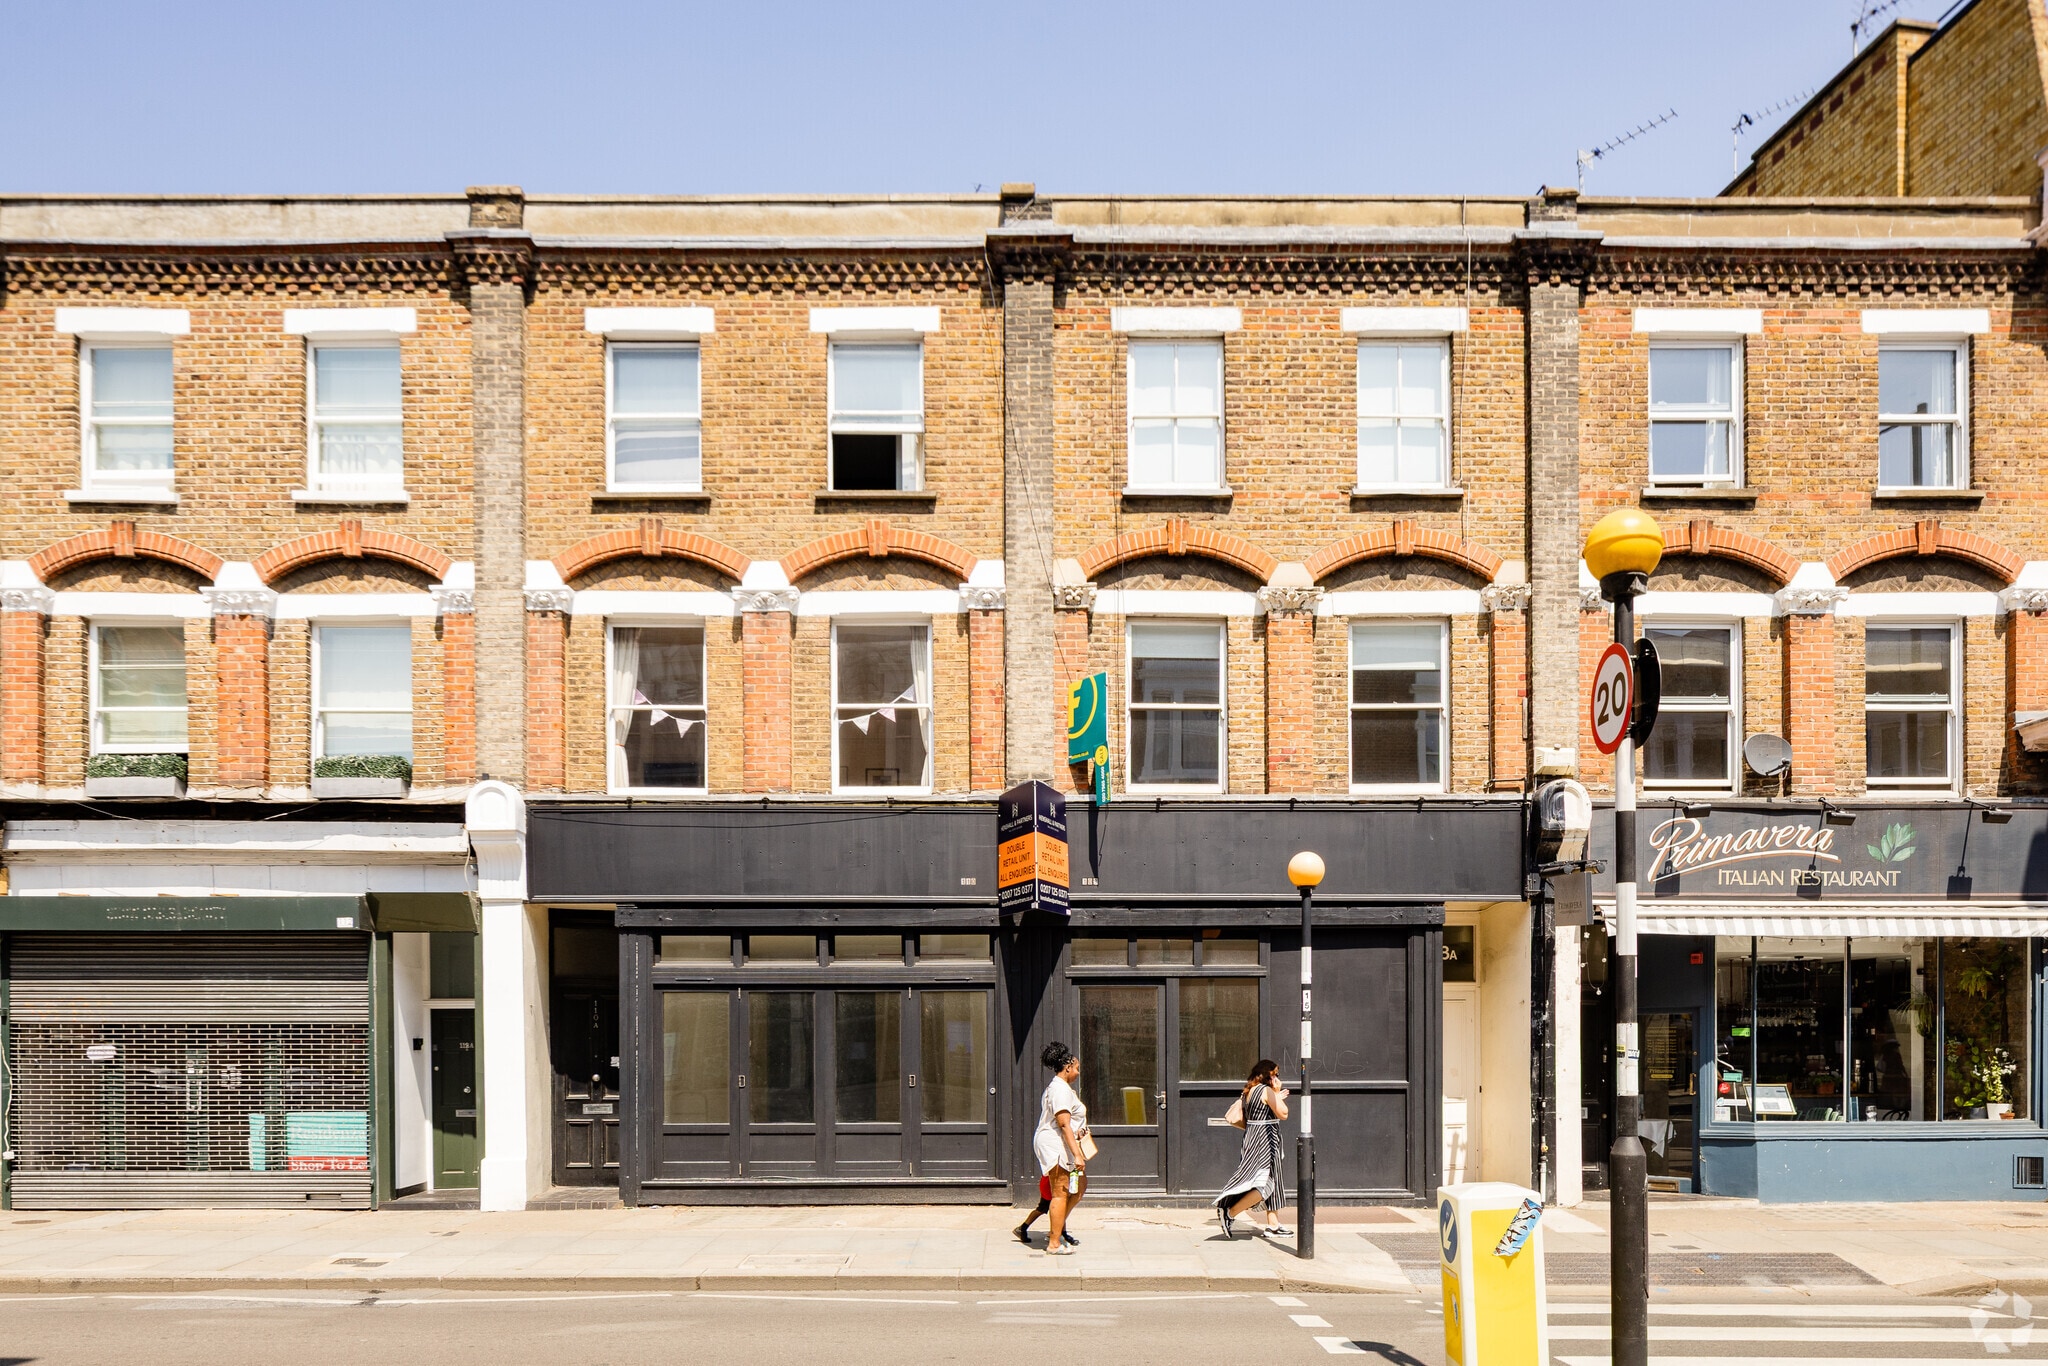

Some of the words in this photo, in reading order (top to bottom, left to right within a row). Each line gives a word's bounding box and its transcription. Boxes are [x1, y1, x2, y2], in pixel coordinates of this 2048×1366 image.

[1597, 671, 1626, 727] 20
[1007, 841, 1025, 854] DOUBLE
[1045, 841, 1061, 854] DOUBLE
[1647, 816, 1837, 882] Primavera
[1003, 856, 1018, 867] RETAIL
[1019, 852, 1030, 863] UNIT
[1042, 852, 1056, 864] RETAIL
[1056, 857, 1065, 867] UNIT
[1000, 872, 1009, 882] ALL
[1009, 864, 1035, 880] ENQUIRIES
[1038, 865, 1047, 875] ALL
[1047, 867, 1068, 882] ENQUIRIES
[1718, 868, 1784, 886] ITALIAN
[1790, 868, 1901, 887] RESTAURANT
[1001, 889, 1013, 900] 0207
[1013, 886, 1021, 897] 125
[1021, 883, 1034, 895] 0377
[1039, 883, 1051, 894] 0207
[1051, 887, 1059, 897] 125
[290, 1160, 324, 1171] Shop
[326, 1159, 345, 1171] To
